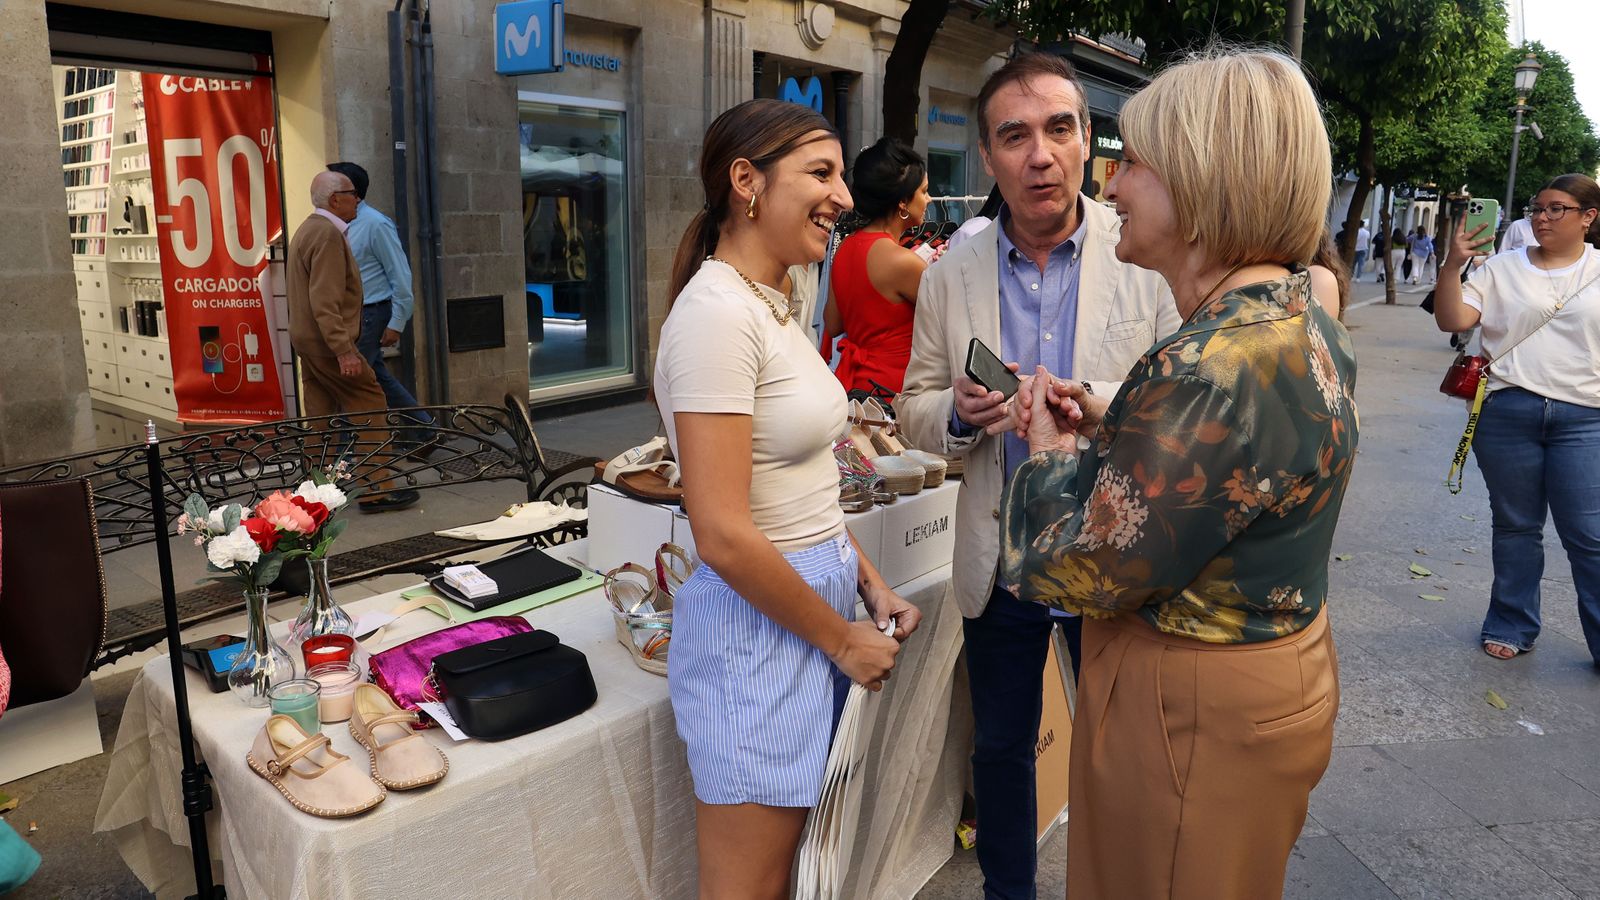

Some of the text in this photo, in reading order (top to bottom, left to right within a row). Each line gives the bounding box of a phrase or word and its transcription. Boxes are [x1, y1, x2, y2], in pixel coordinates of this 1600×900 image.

[192, 299, 261, 308] ON CHARGERS
[1465, 412, 1478, 434] HELLO
[1452, 436, 1470, 465] MONDAY
[905, 515, 948, 547] LEKIAM
[1035, 729, 1055, 759] KIAM
